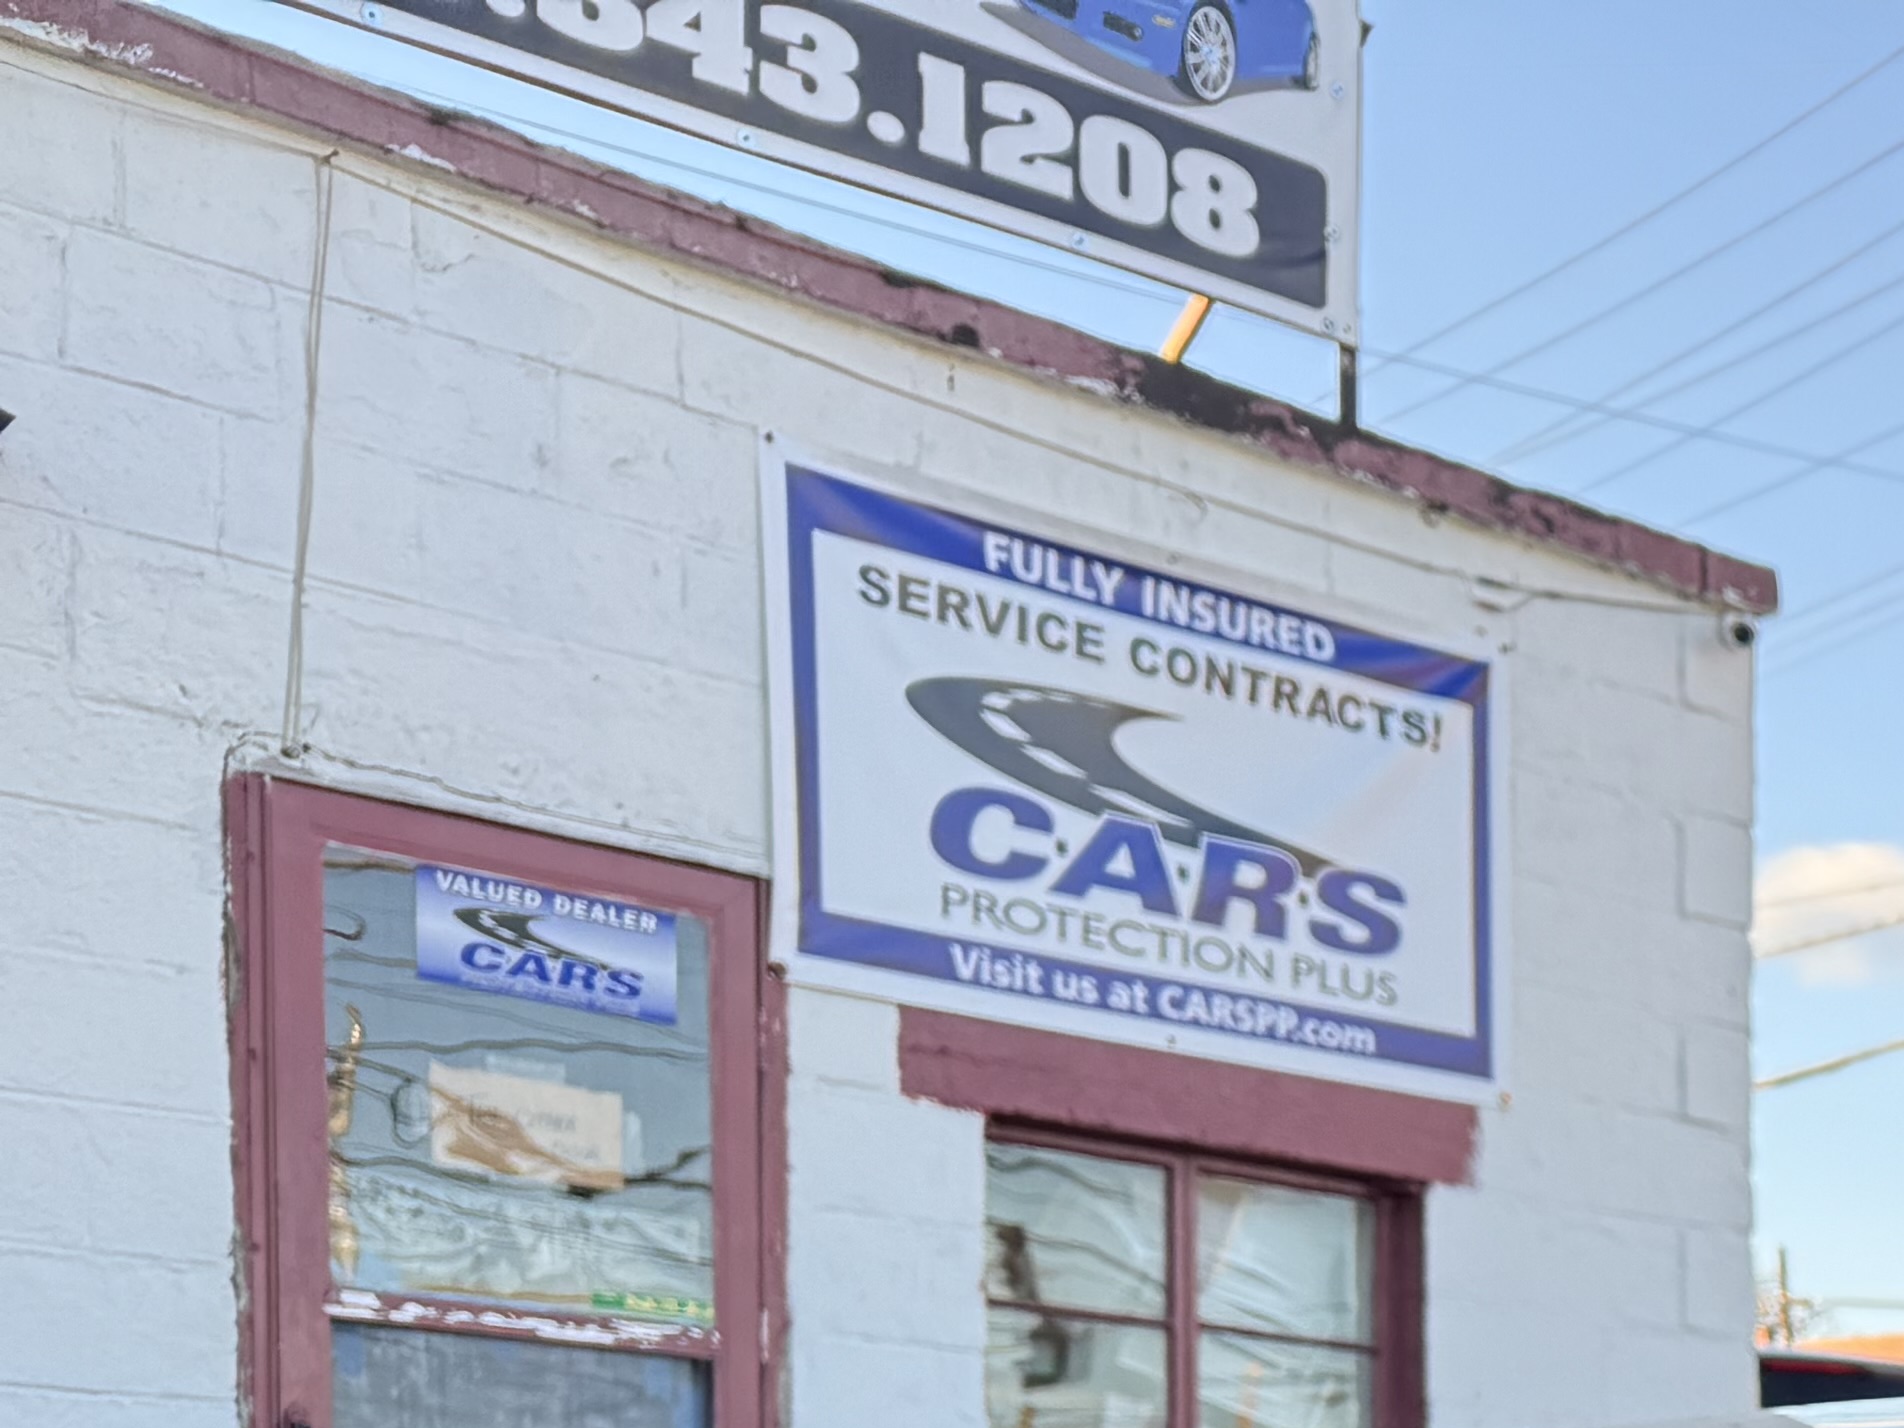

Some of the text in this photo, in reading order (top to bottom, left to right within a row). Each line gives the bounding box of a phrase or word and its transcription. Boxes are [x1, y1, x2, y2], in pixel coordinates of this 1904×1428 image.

[982, 530, 1335, 662] FULLY INSURED
[857, 565, 1443, 750] SERVICE CONTRACTS!
[435, 869, 658, 934] VALUED DEALER
[940, 884, 1399, 1006] PROTECTION PLUS
[948, 944, 1376, 1053] Visit us at CARSPP.com
